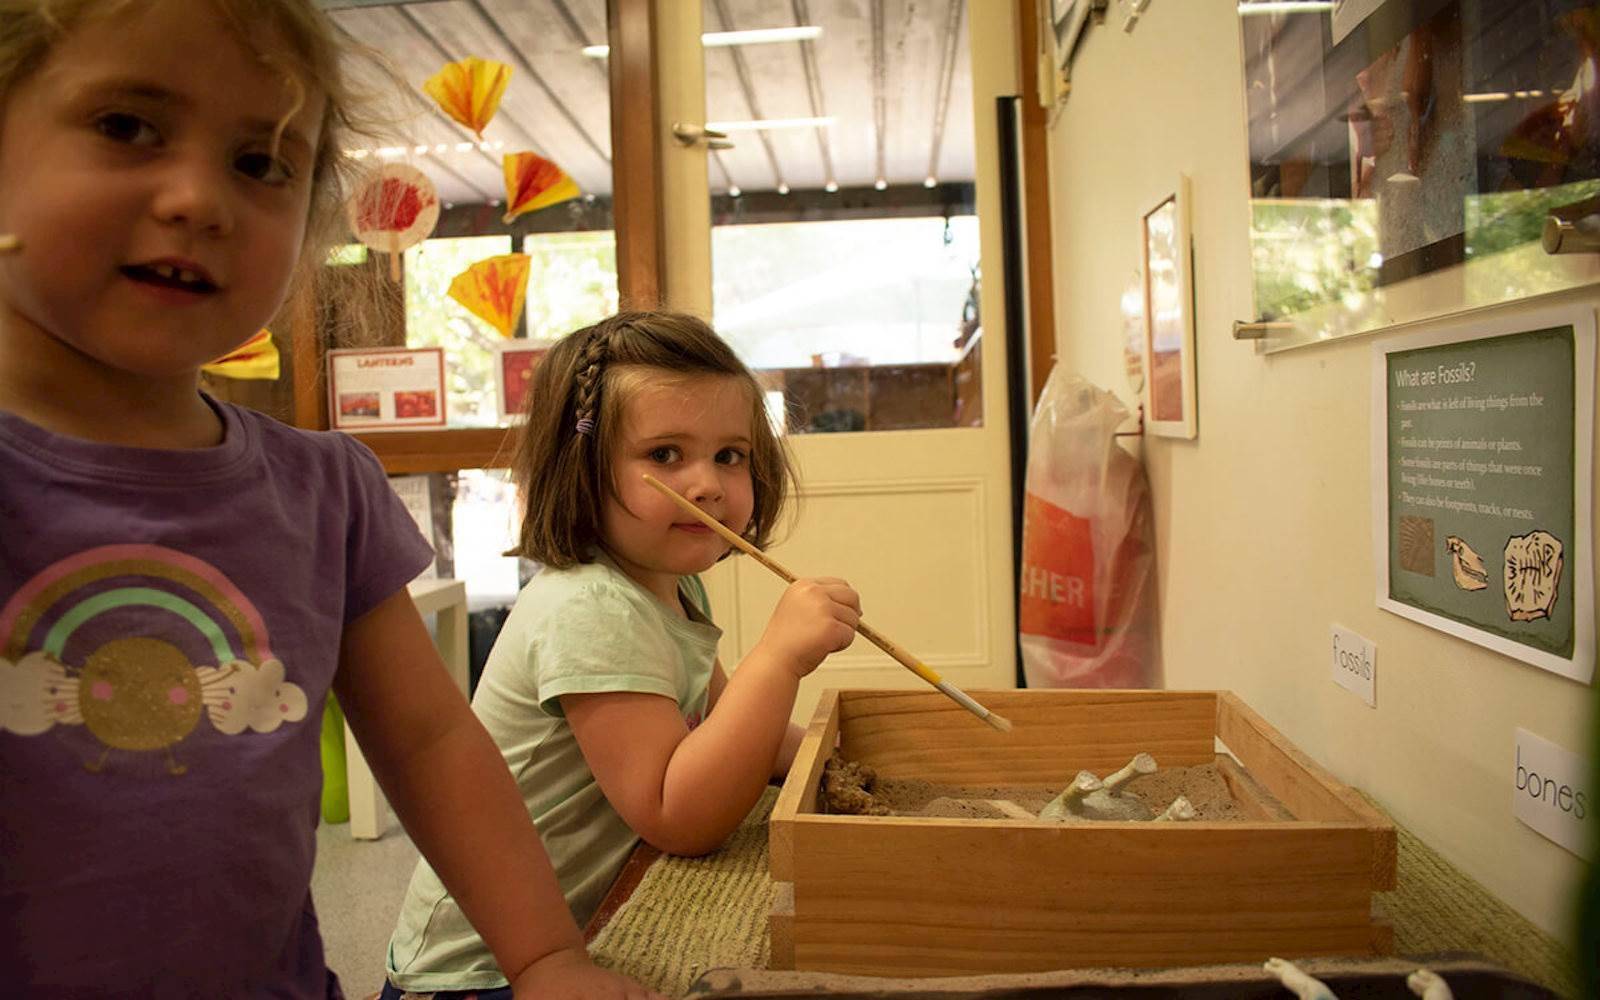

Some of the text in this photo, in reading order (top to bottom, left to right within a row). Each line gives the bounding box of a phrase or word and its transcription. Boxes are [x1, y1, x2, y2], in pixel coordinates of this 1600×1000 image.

[357, 357, 415, 368] LANTERNS
[1395, 361, 1475, 388] What are Fossils?
[1333, 633, 1371, 681] fossils
[1515, 744, 1586, 820] bones
